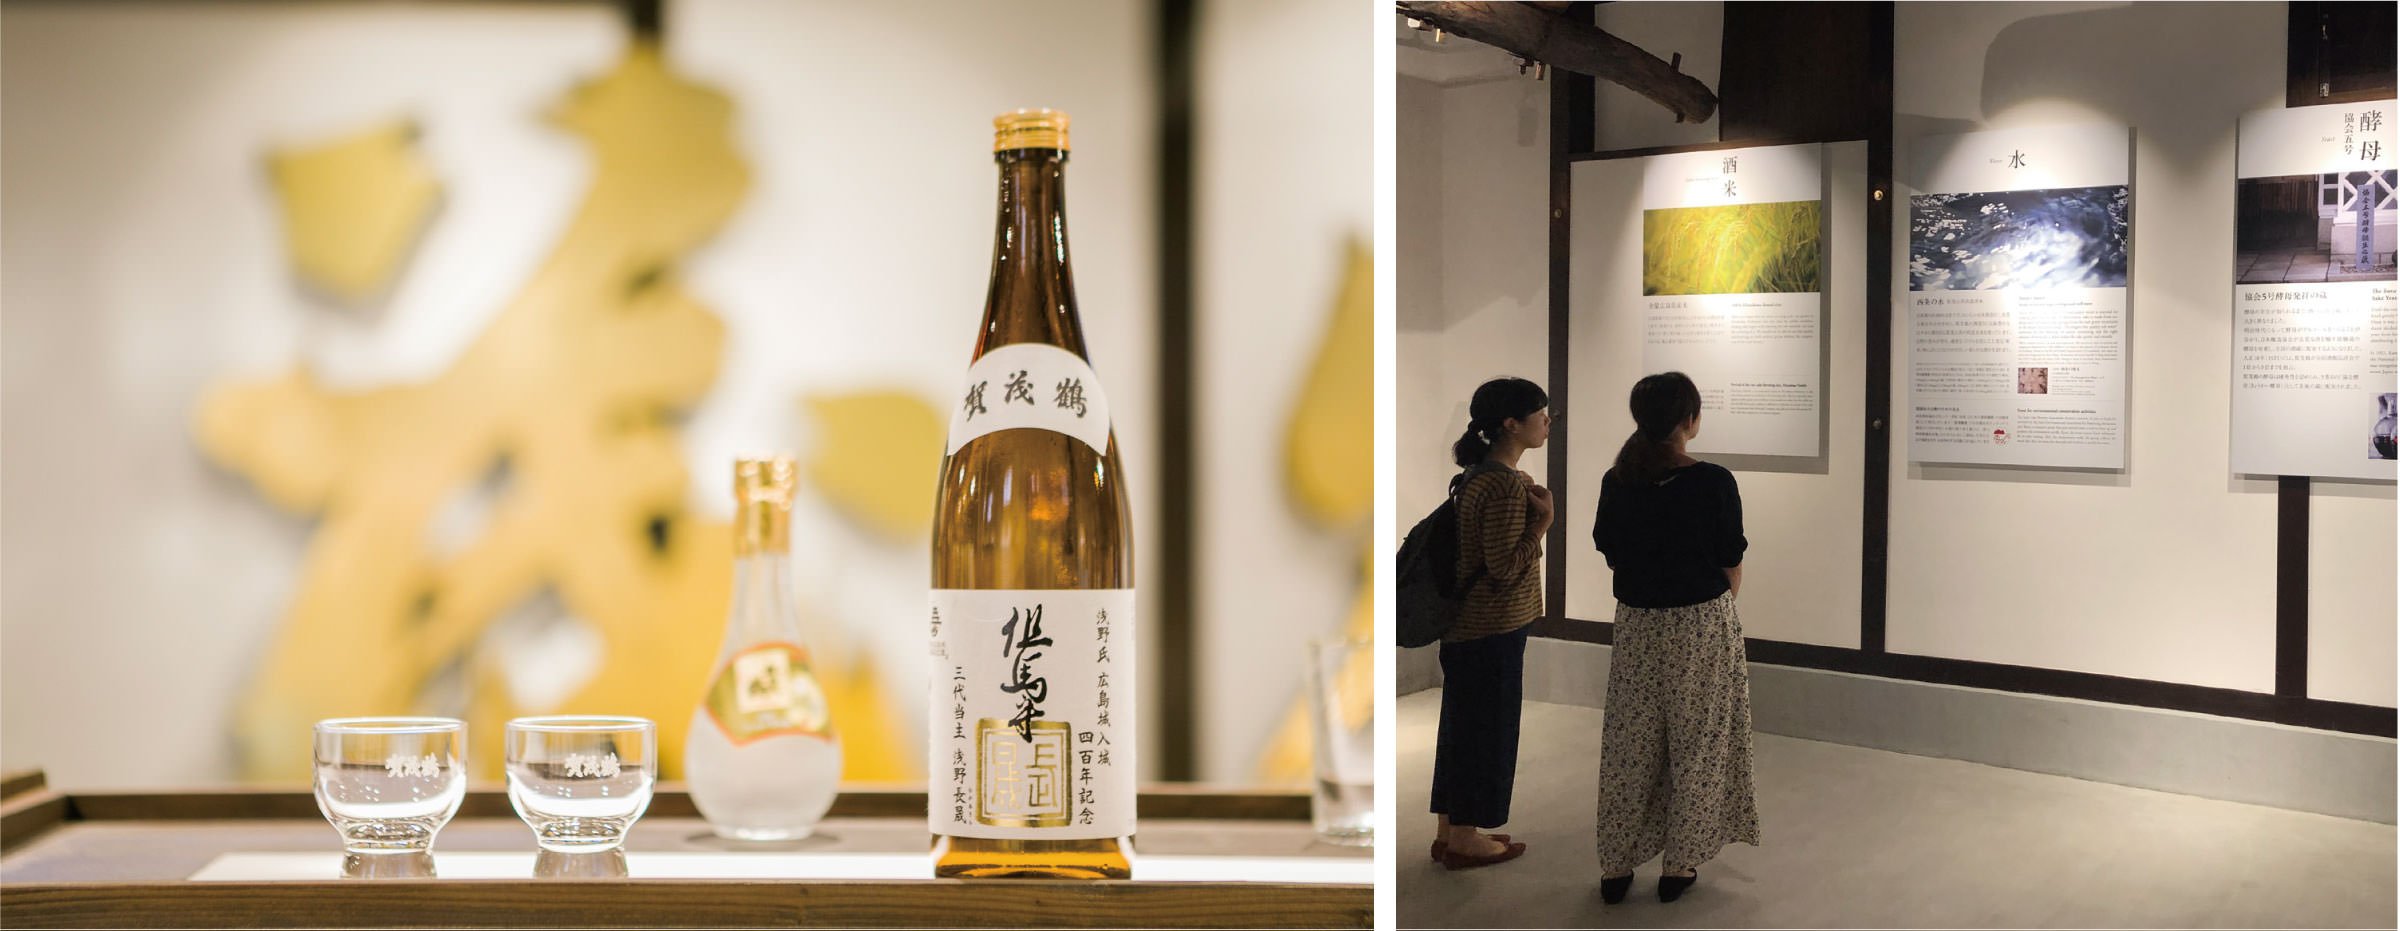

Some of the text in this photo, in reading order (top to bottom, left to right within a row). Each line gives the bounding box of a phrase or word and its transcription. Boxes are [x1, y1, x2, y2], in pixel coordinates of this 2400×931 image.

[2008, 150, 2026, 168] 水
[2344, 113, 2354, 155] 協会五号
[2360, 110, 2382, 161] 酵母
[1723, 156, 1738, 197] 酒米
[963, 370, 1087, 421] 賀茂鶴
[953, 666, 966, 739] 三代当主
[1078, 731, 1095, 825] 四百年記念
